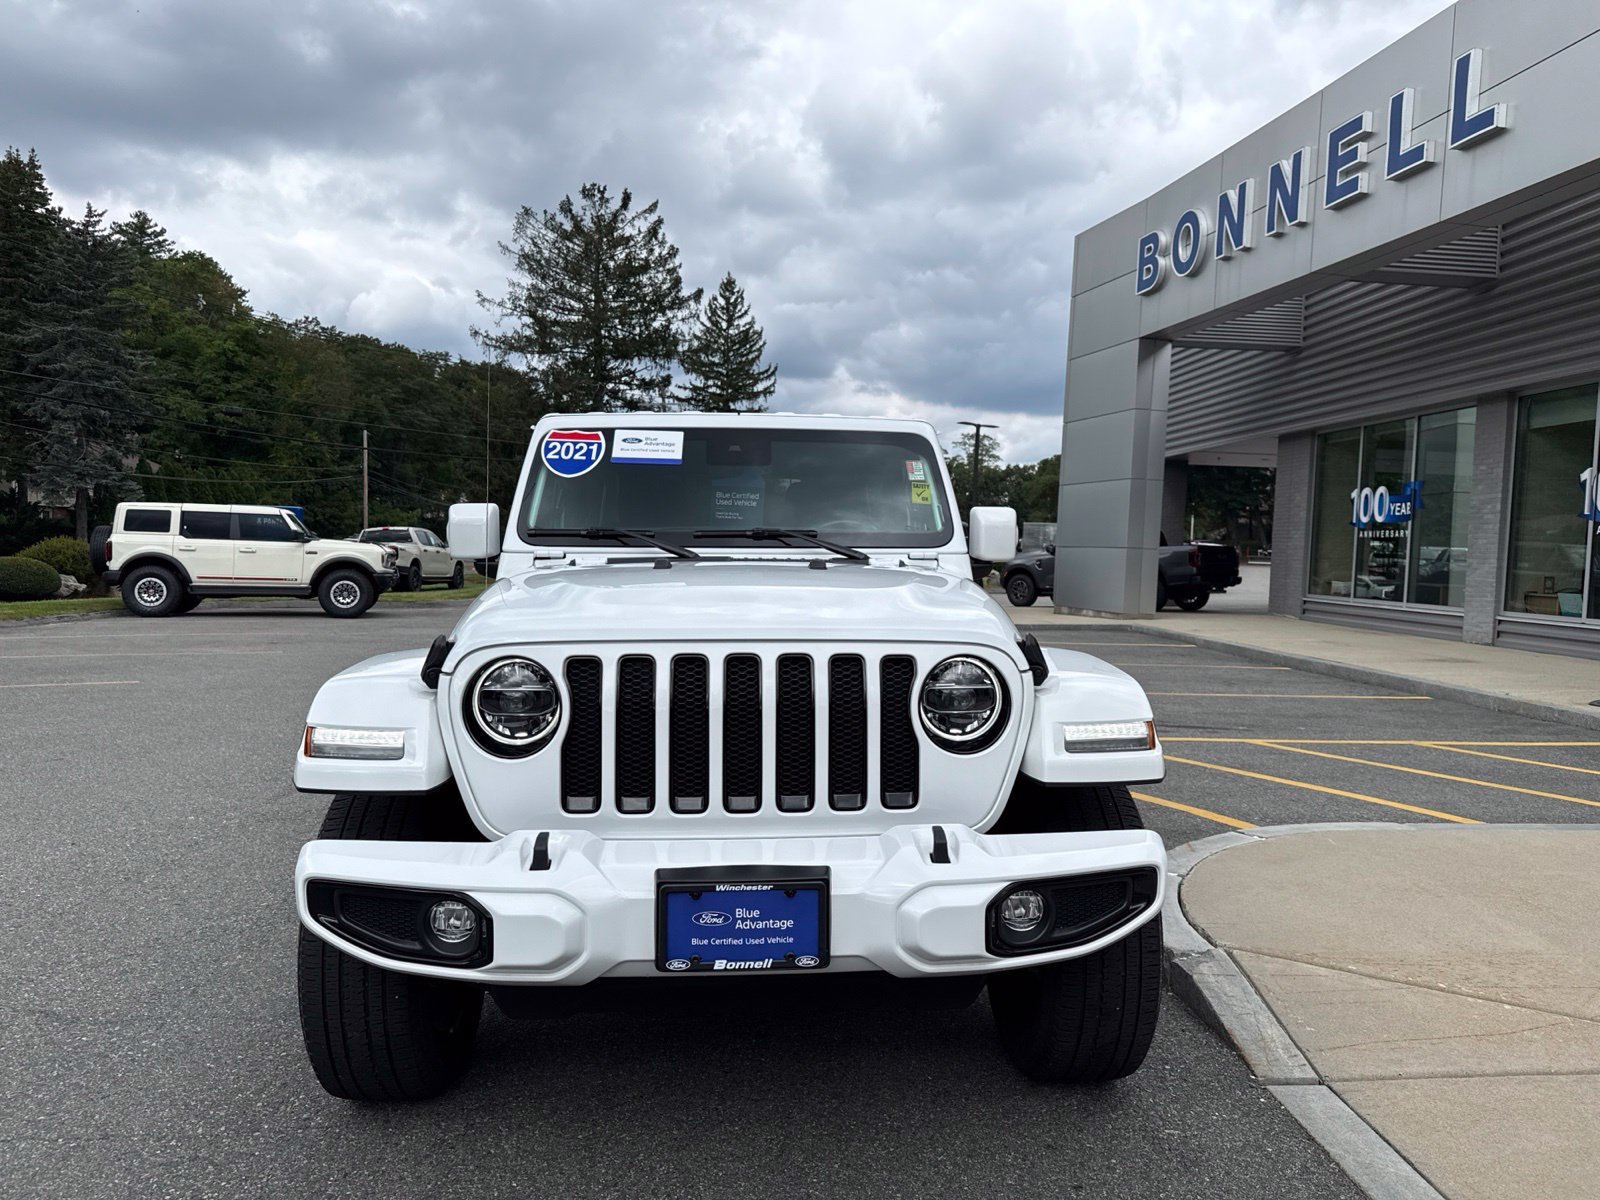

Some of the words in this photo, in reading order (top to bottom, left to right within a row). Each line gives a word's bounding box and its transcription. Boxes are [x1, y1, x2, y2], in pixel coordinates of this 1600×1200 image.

[1136, 47, 1508, 297] BONNELL
[546, 441, 598, 460] 2021
[731, 492, 760, 500] Certified
[733, 499, 758, 507] Vehicle
[1350, 486, 1390, 523] 100
[1359, 529, 1409, 538] ANNIVERSARY
[715, 884, 774, 892] Winchester
[735, 908, 760, 918] Blue
[698, 912, 726, 925] Ford
[735, 919, 794, 930] Advantage
[710, 937, 743, 945] Certified
[745, 937, 765, 945] Used
[767, 936, 794, 944] Vehicle
[669, 960, 690, 970] Ford
[713, 958, 773, 970] Bonnell
[797, 957, 817, 966] Ford
